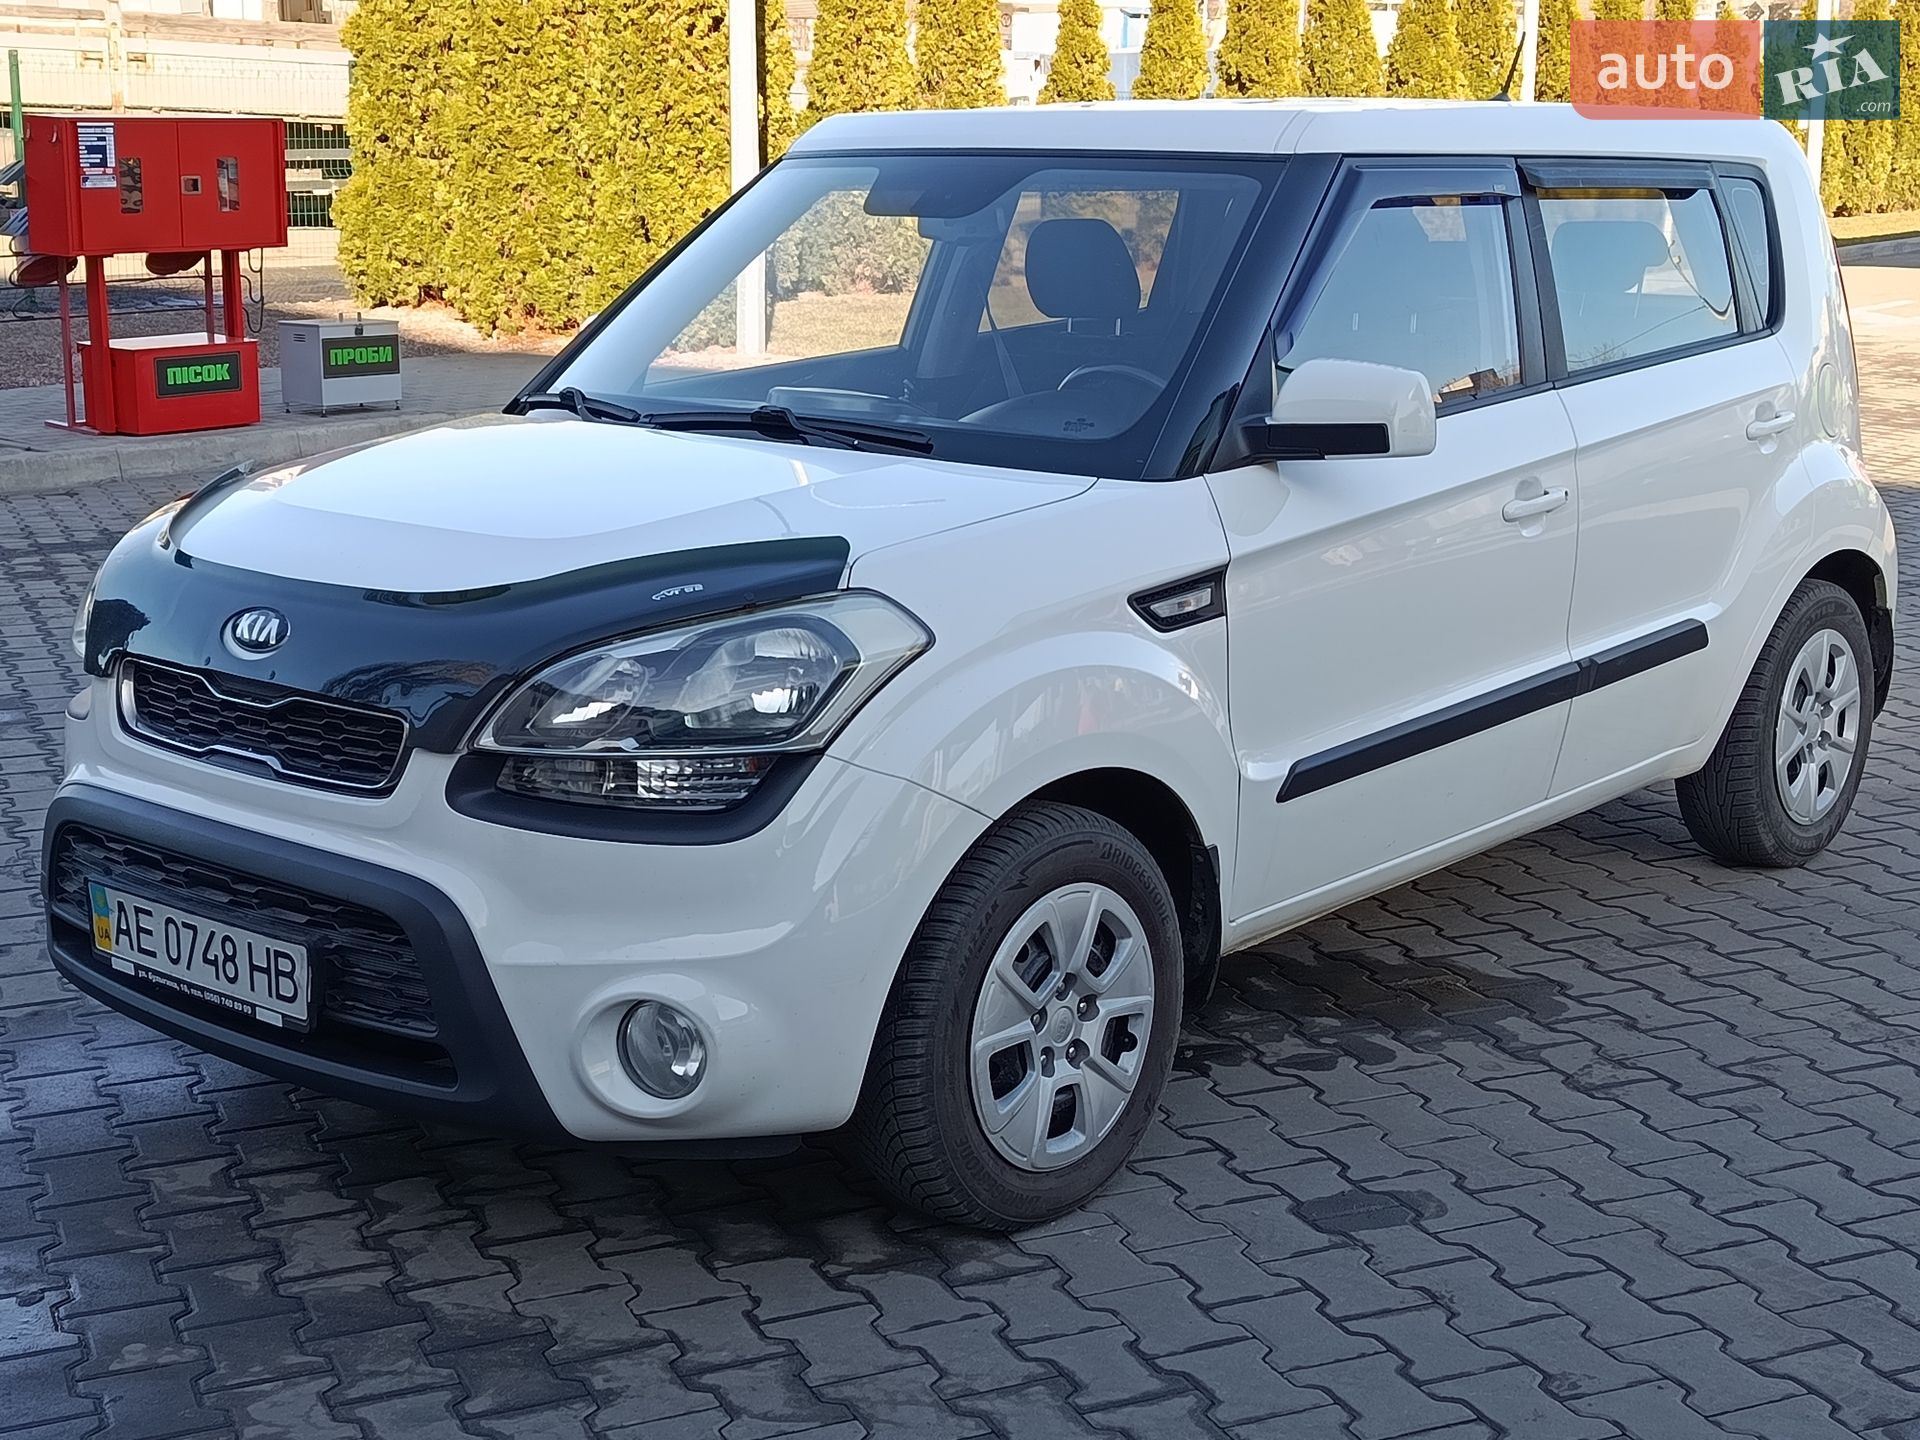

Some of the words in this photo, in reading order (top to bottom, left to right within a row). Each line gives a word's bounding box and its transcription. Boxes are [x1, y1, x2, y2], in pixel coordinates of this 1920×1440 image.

[329, 347, 393, 367] ПРОБИ
[167, 363, 231, 385] ПІСОК
[236, 613, 280, 645] KIA
[1099, 842, 1172, 927] BRIDGESTONE
[97, 926, 111, 941] UA
[115, 900, 157, 959] AE
[164, 916, 239, 985] 0748
[247, 941, 299, 1004] HB
